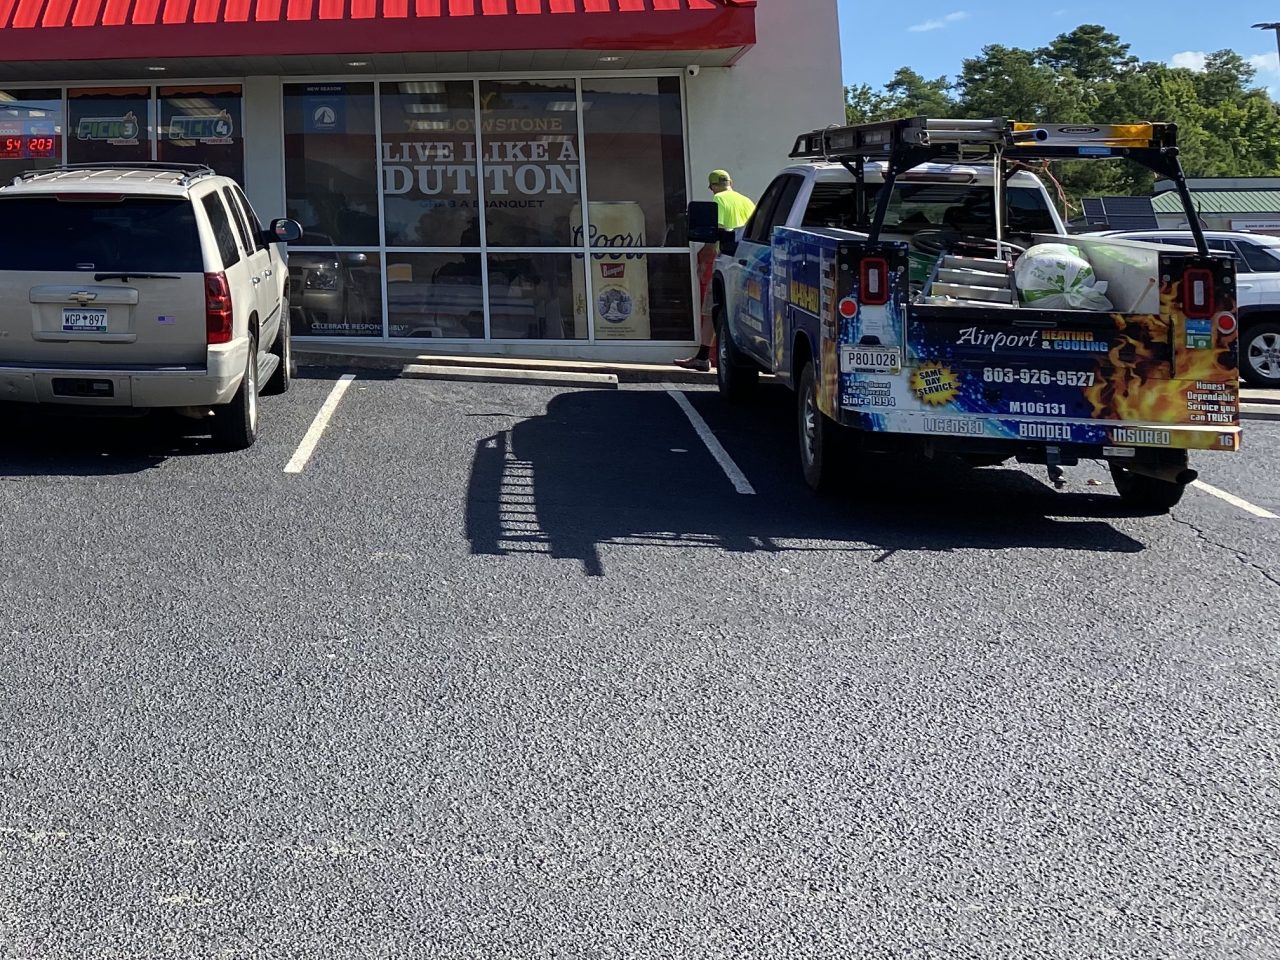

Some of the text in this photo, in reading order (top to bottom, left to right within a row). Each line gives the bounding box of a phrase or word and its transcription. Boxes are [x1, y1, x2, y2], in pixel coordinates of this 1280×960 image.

[80, 121, 134, 137] PICK 3
[171, 120, 228, 137] PICK 4
[404, 117, 563, 133] YLOWSTONE
[6, 139, 21, 151] 54
[29, 138, 53, 151] 203
[382, 140, 579, 162] LIVE LIKE A
[382, 164, 579, 195] DUTTON
[460, 200, 470, 208] A
[572, 224, 646, 260] Coors
[64, 314, 105, 326] WGP 897
[311, 322, 405, 331] CELEBRATE RESPONIBLY
[956, 327, 1094, 352] Airport HEATING
[1041, 340, 1109, 352] & COOLING
[848, 352, 896, 366] P801028
[920, 368, 943, 380] SAME
[983, 367, 1095, 387] 803-926-9527
[925, 377, 941, 386] DAY
[1196, 381, 1226, 390] Honest
[917, 382, 953, 396] SERVICE
[842, 395, 896, 407] Since 1994
[1187, 392, 1236, 403] Dependable
[1009, 401, 1066, 415] M106131
[1187, 402, 1236, 414] Service you
[1207, 414, 1234, 423] TRUST
[923, 418, 984, 435] LICENSED
[1019, 423, 1071, 439] BONDED
[1112, 428, 1170, 445] INSURED
[1218, 435, 1233, 446] 16
